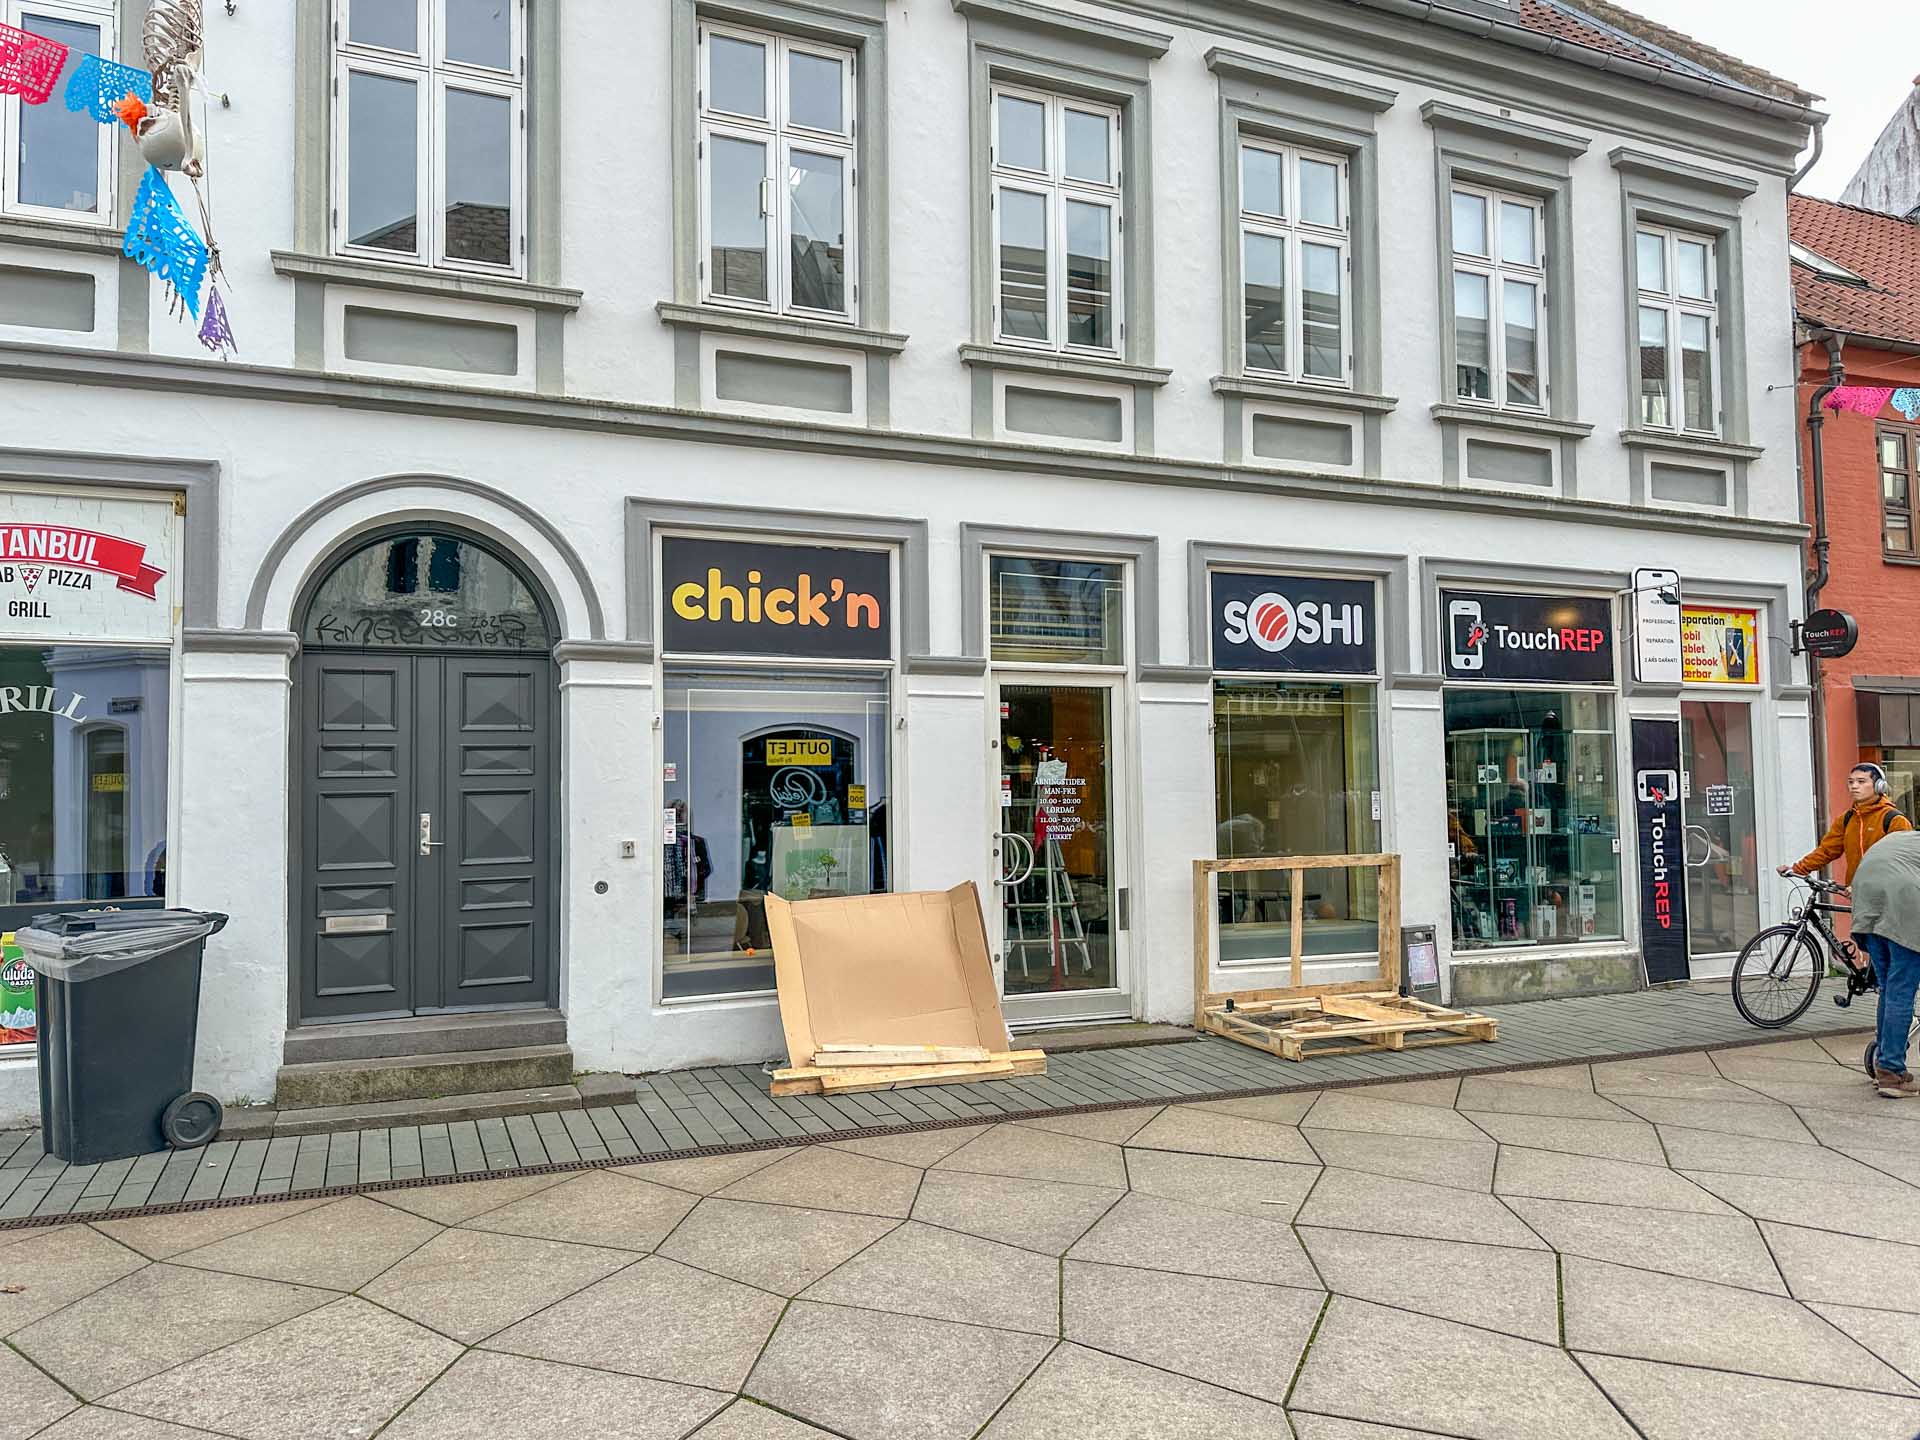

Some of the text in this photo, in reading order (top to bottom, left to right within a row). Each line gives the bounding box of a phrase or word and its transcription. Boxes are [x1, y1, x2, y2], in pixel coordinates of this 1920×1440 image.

[47, 568, 92, 590] PIZZA
[671, 567, 881, 629] chick'n
[8, 600, 52, 618] GRILL
[420, 609, 457, 628] 28c
[1223, 591, 1363, 653] SOSHI
[1493, 625, 1605, 653] TouchREP
[1034, 777, 1086, 785] ÅBNINGSTIDER
[1046, 806, 1075, 814] LØRDAG
[1045, 825, 1075, 833] SØNDAG
[1651, 813, 1671, 929] TouchREP
